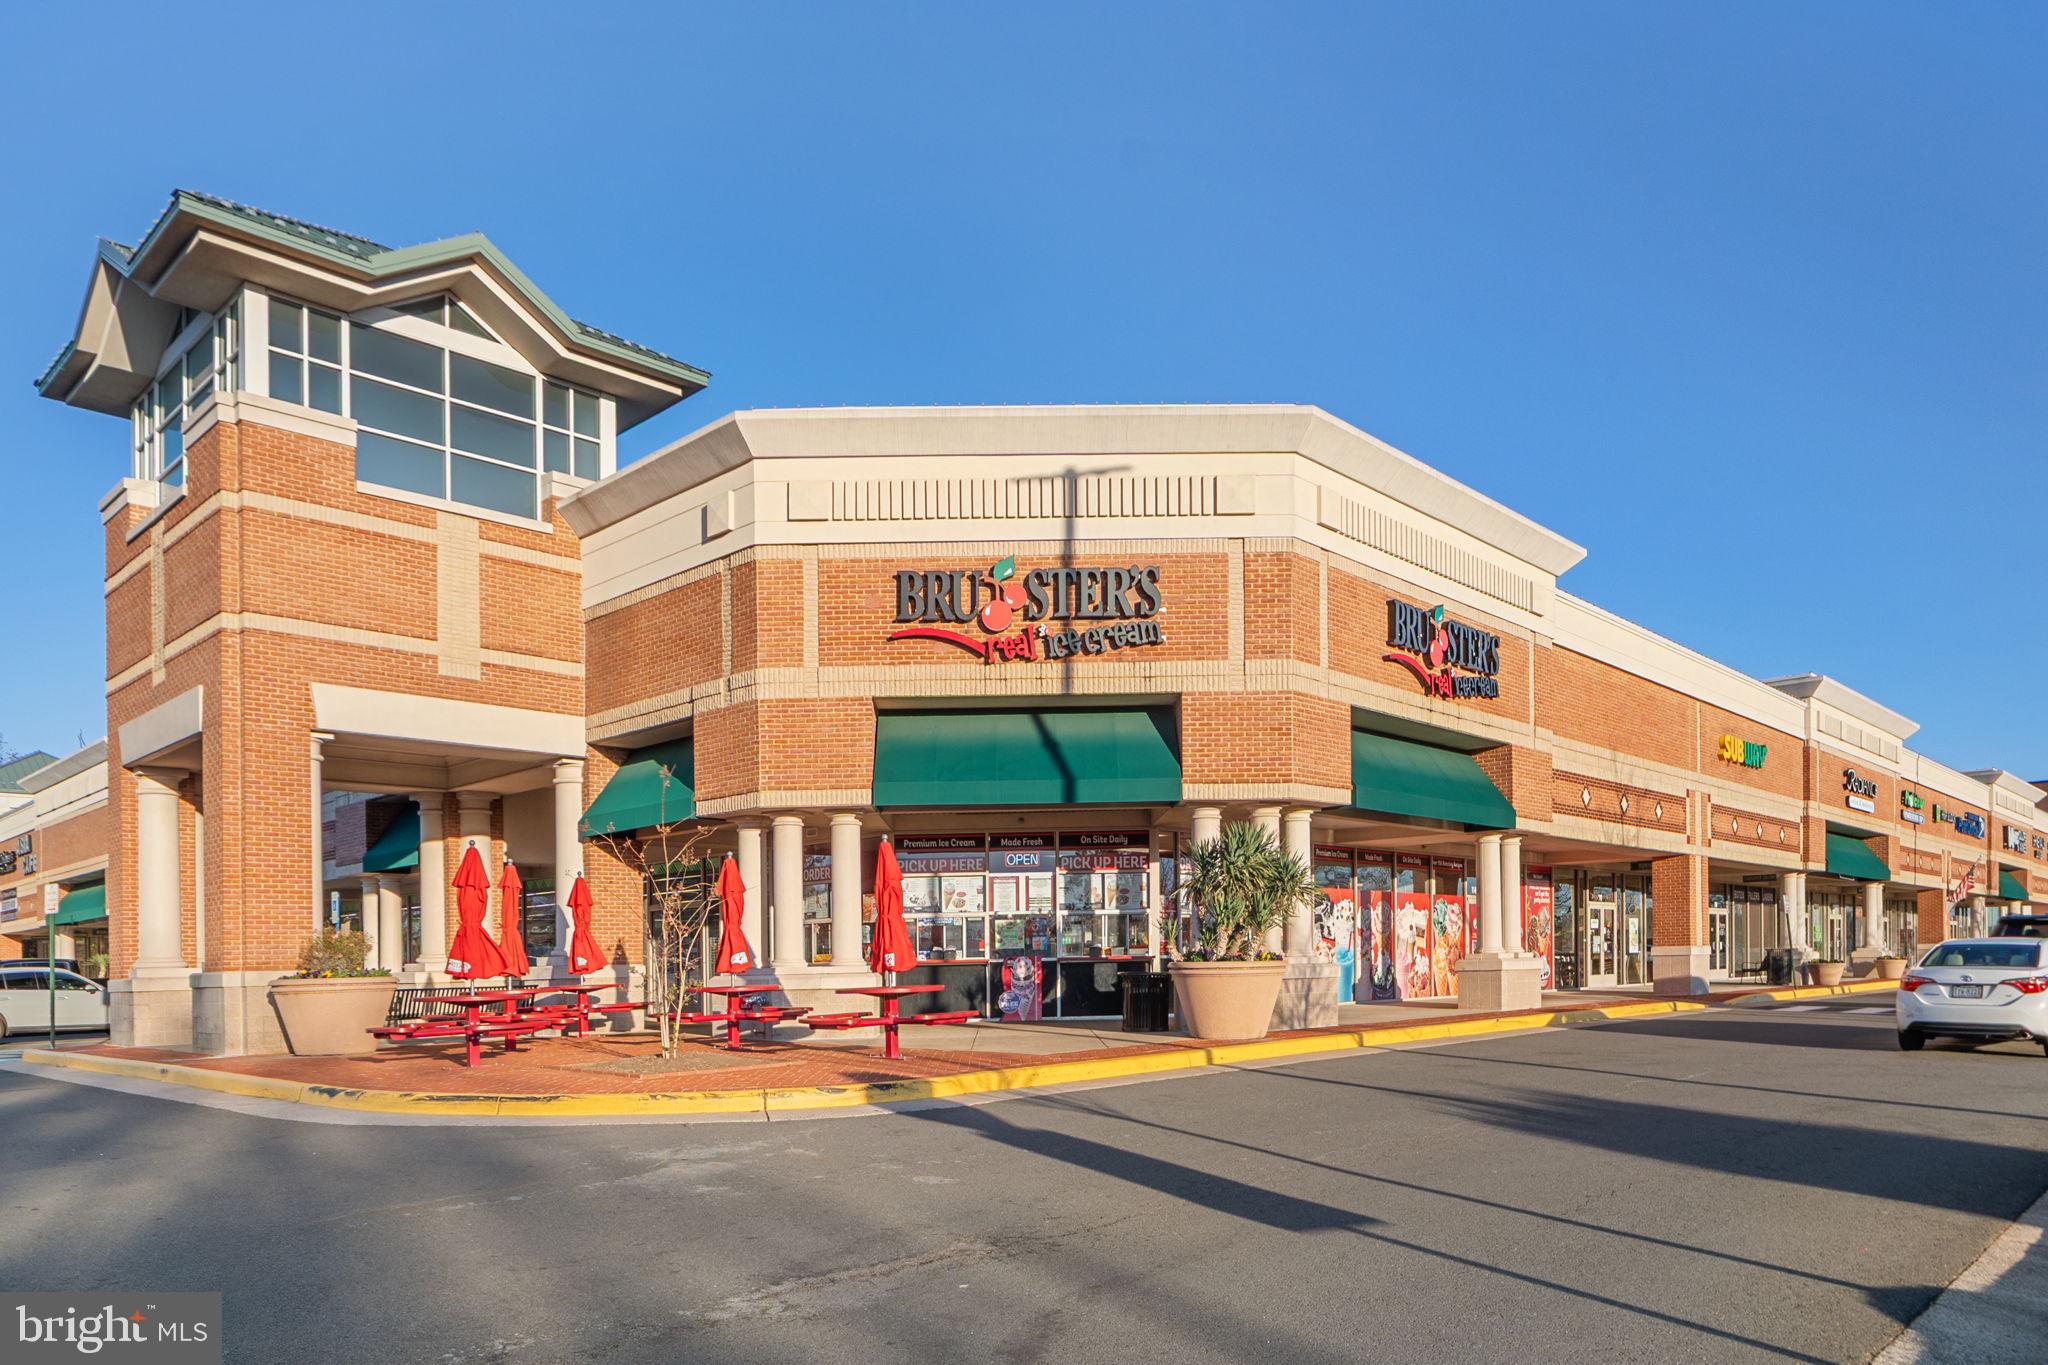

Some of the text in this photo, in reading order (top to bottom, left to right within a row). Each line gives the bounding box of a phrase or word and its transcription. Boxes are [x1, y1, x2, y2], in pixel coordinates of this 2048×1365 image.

[986, 621, 1164, 664] real ice cream
[1430, 668, 1454, 699] real
[1717, 735, 1768, 769] SUBWAY
[903, 838, 976, 848] Premium Ice Cream
[1000, 837, 1043, 847] Made Fresh
[1080, 835, 1128, 845] On Site Daily
[897, 858, 984, 873] PICK UP HERE
[1006, 853, 1038, 866] OPEN
[1060, 855, 1147, 869] PICK UP HERE
[803, 868, 832, 881] ORDER
